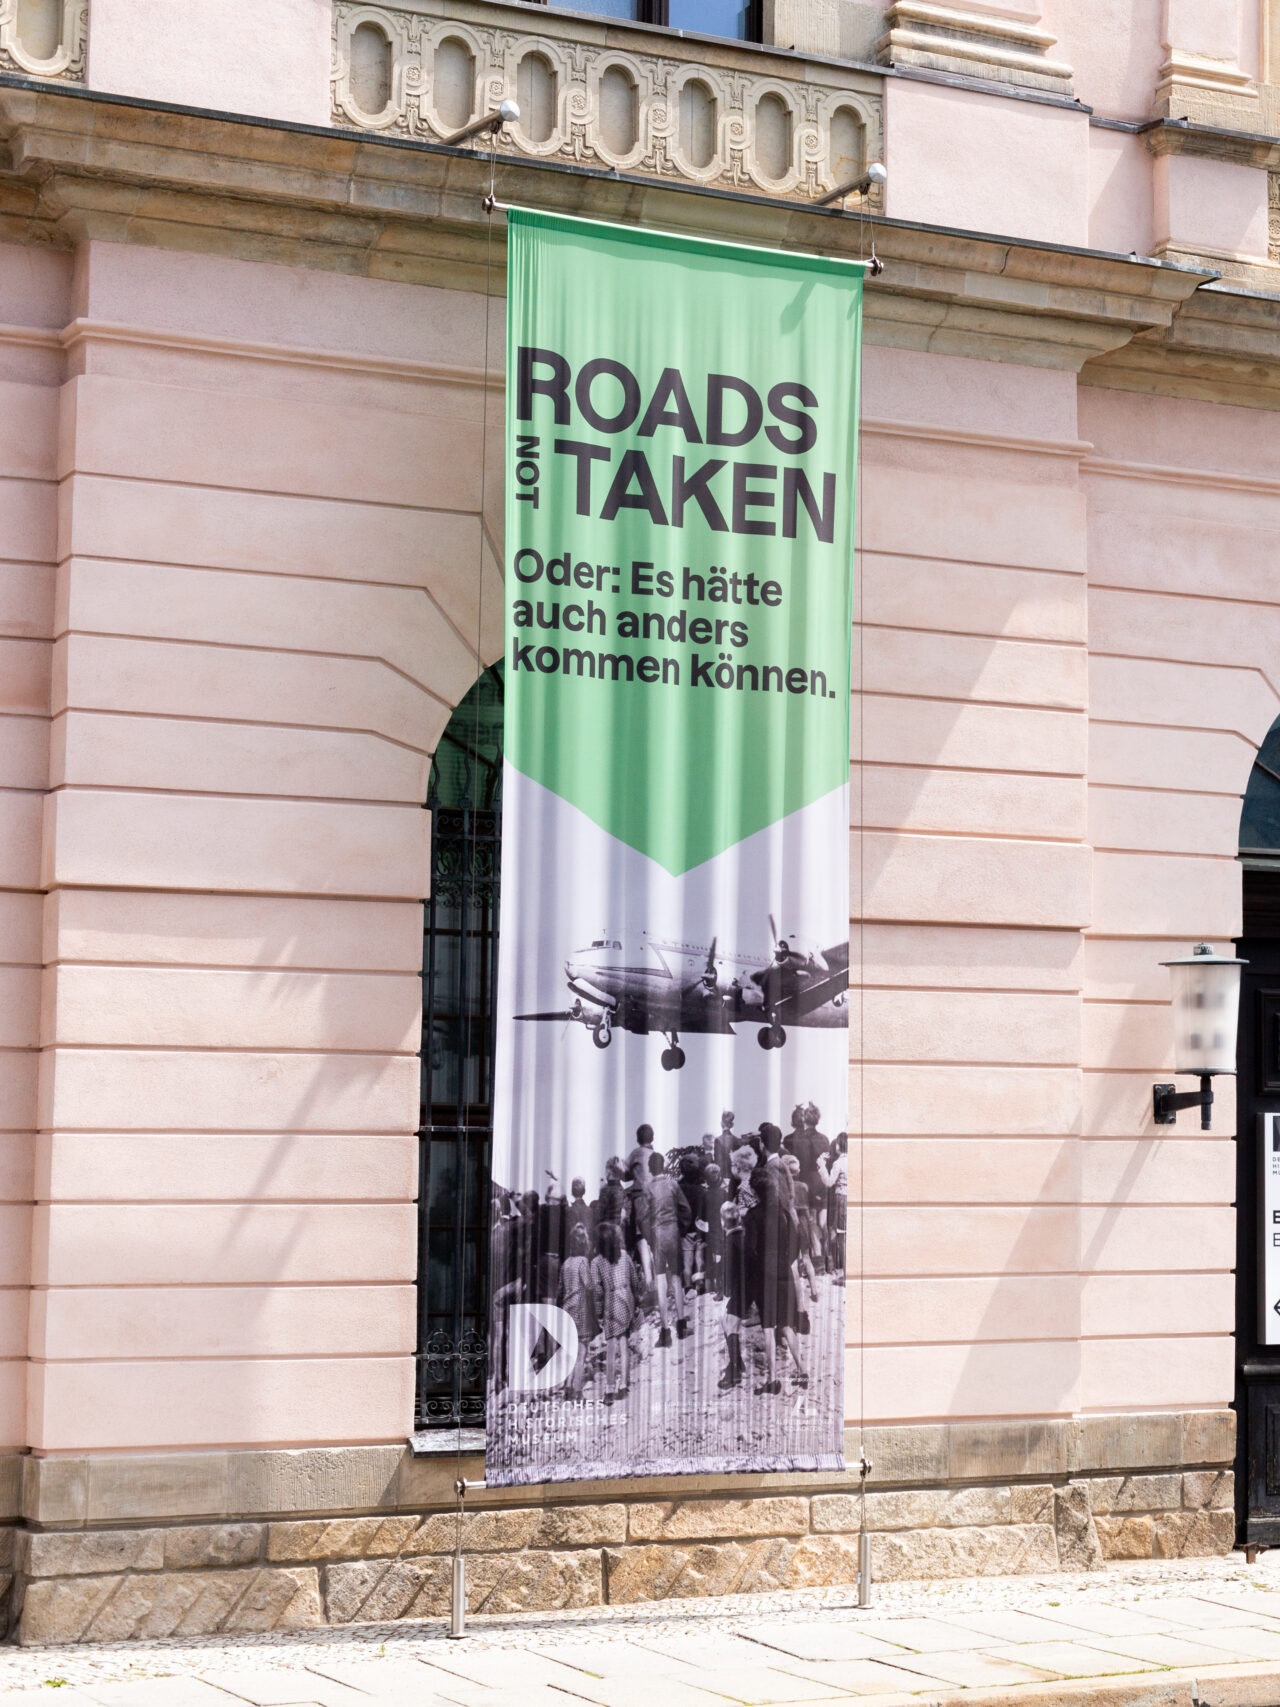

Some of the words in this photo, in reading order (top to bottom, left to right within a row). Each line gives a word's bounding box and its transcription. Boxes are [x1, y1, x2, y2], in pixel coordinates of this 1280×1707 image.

[516, 346, 819, 455] ROADS
[515, 435, 540, 510] NOT
[554, 438, 837, 544] TAKEN
[513, 548, 621, 594] Oder:
[631, 561, 674, 598] Es
[682, 566, 783, 607] hätte
[512, 599, 607, 636] auch
[616, 609, 749, 648] anders
[512, 637, 680, 686] kommen
[690, 653, 836, 699] können.
[508, 1399, 605, 1415] DEUTSCHES
[508, 1431, 578, 1445] MUSEUM
